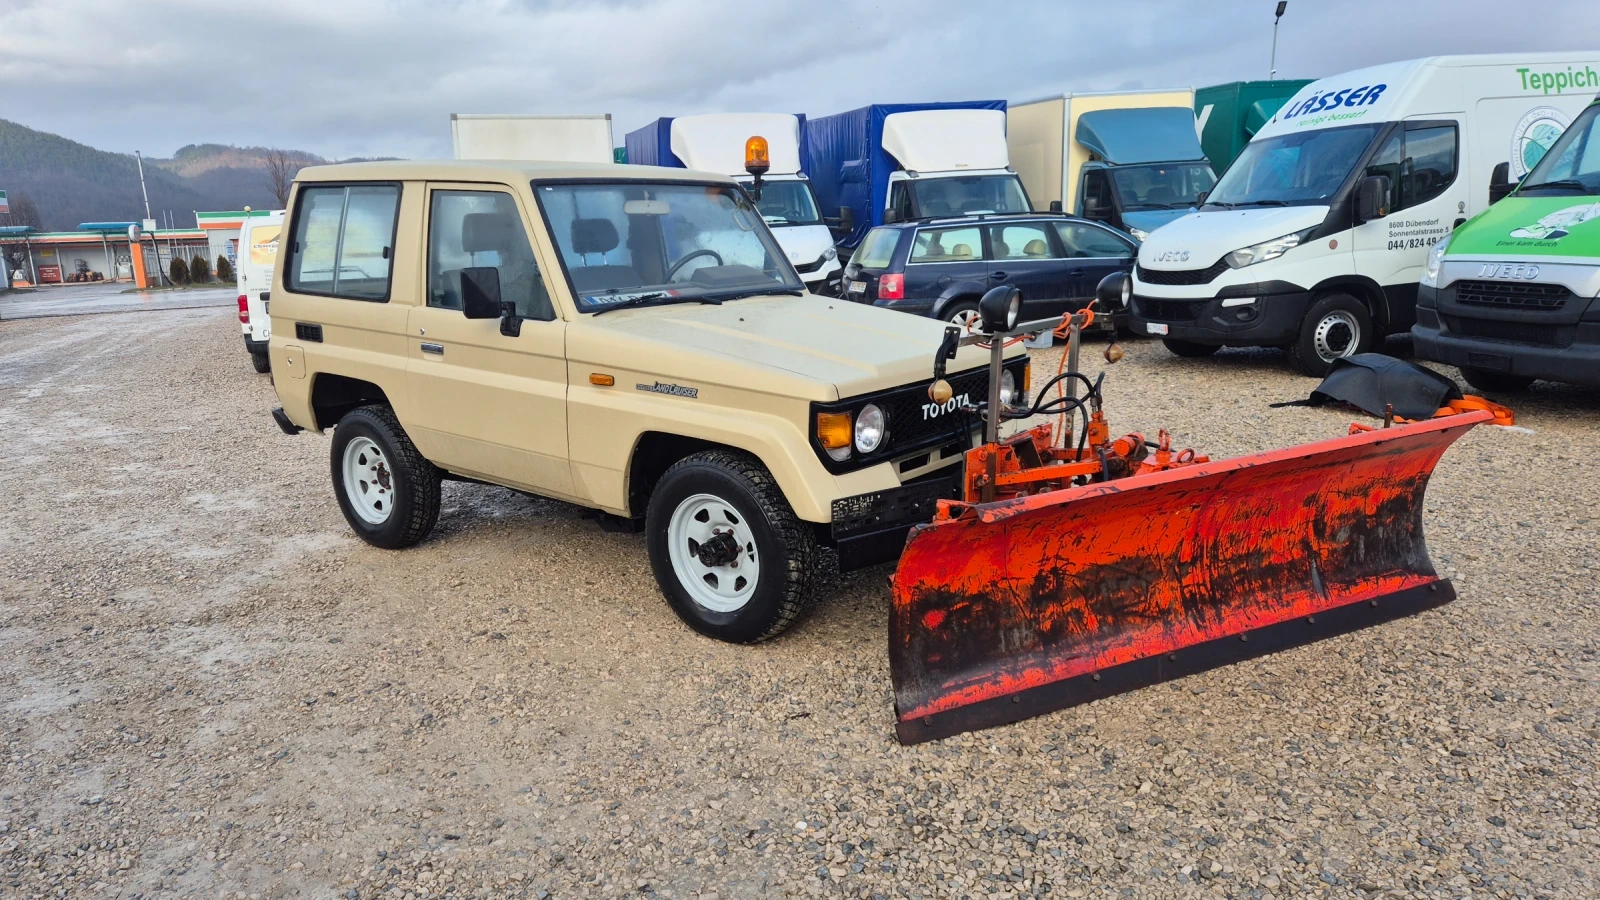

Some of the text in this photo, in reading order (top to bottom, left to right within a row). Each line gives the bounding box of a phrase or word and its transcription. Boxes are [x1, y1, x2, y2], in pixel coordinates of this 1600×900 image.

[1516, 66, 1600, 95] Teppich
[1283, 83, 1388, 120] LÄSSER
[1388, 218, 1439, 229] 8600 Dübendorf
[1388, 228, 1444, 238] Sonnentalstrasse
[1388, 238, 1425, 251] 044/824
[1534, 240, 1558, 248] durch
[1153, 250, 1190, 262] IVECO
[1478, 263, 1540, 280] IVECO
[669, 384, 698, 399] CRUISER
[921, 393, 970, 420] TOYOTA
